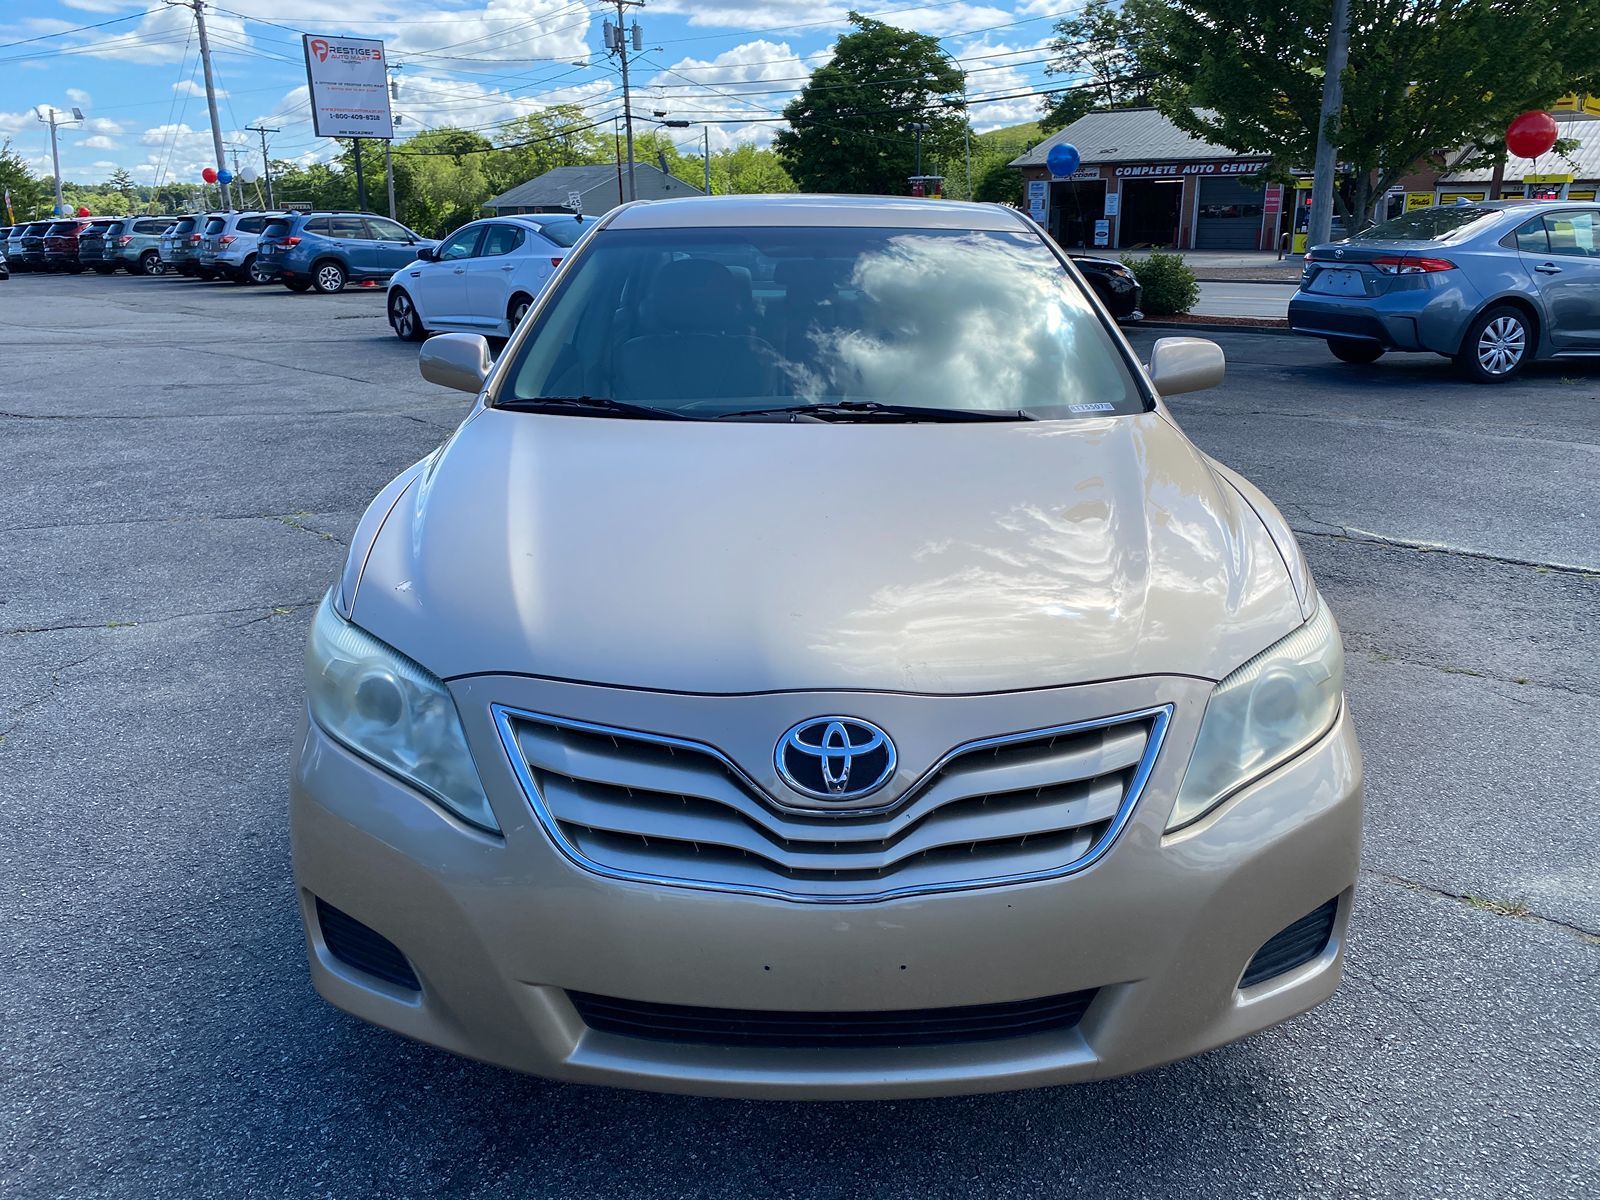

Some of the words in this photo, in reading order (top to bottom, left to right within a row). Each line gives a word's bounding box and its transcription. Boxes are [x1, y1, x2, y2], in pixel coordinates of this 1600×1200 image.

[371, 49, 381, 60] 3
[1115, 166, 1177, 176] COMPLETE
[1182, 164, 1215, 174] AUTO
[1220, 163, 1267, 173] CENTE
